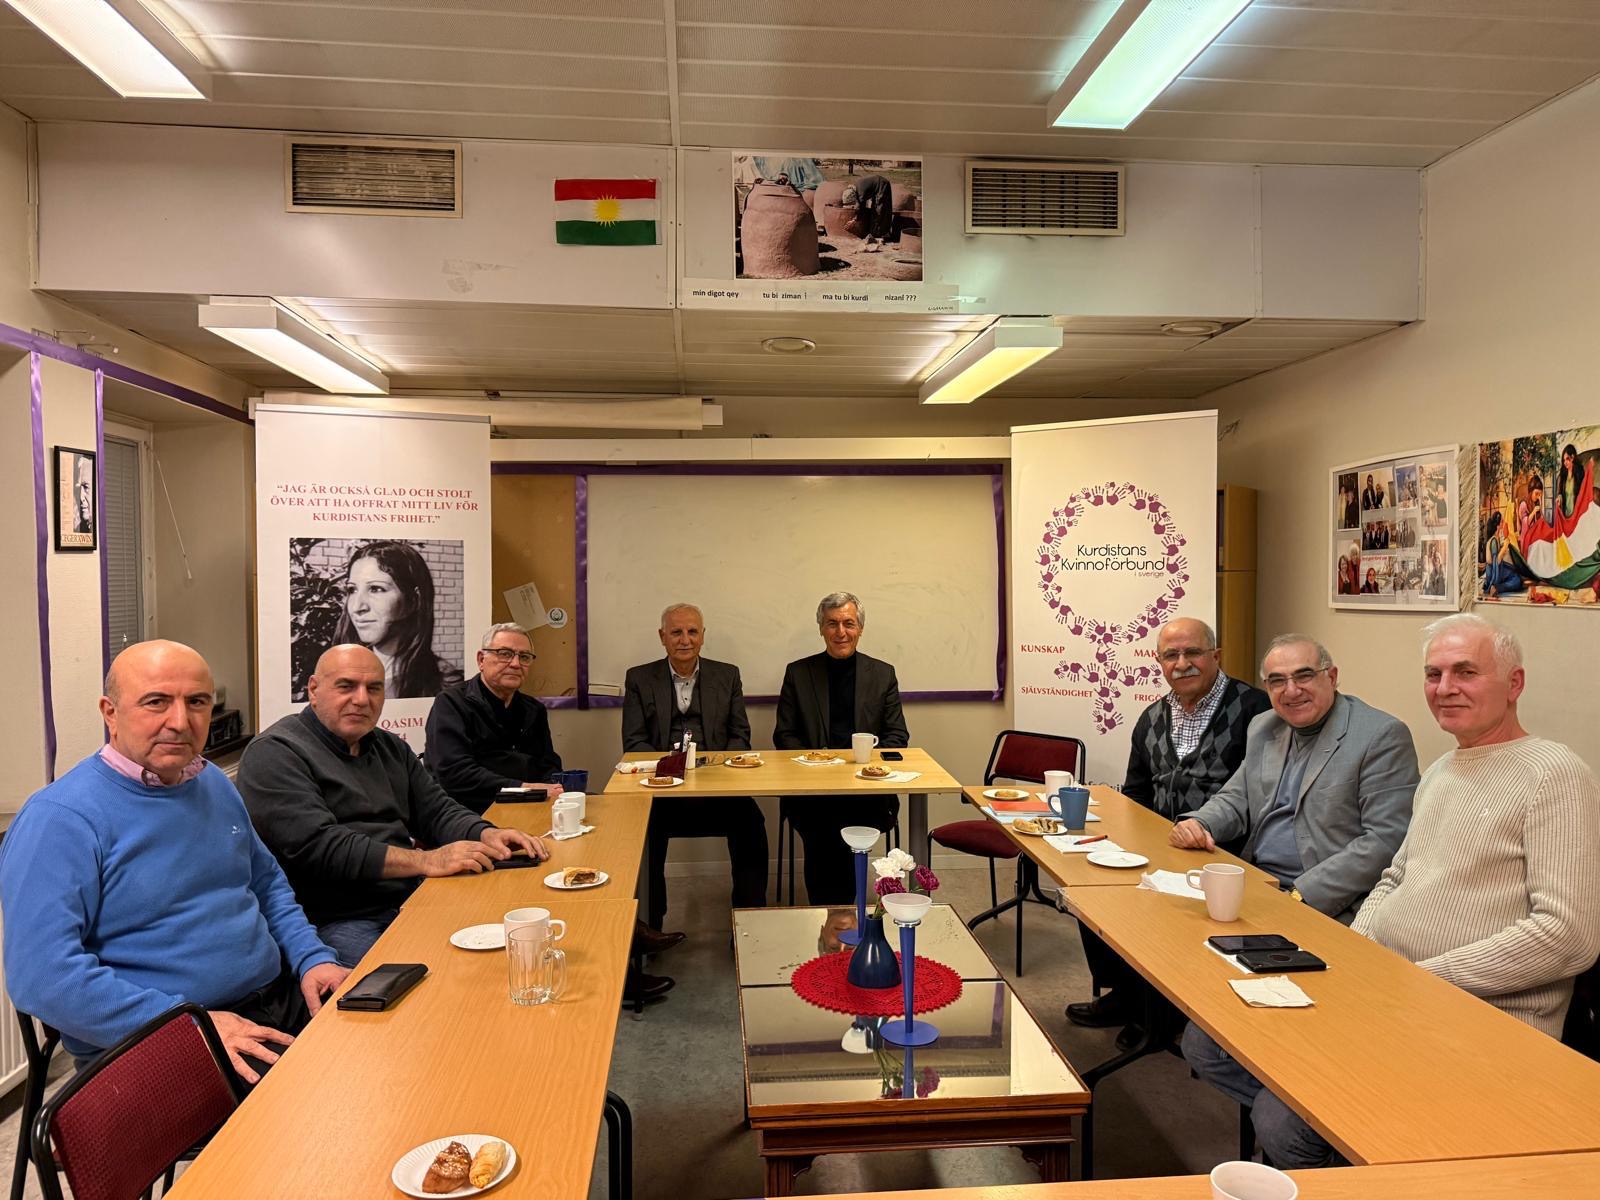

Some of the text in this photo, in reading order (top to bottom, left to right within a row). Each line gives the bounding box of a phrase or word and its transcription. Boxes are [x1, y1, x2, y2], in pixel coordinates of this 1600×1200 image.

[707, 289, 725, 298] digot
[771, 291, 779, 299] bi
[781, 291, 802, 299] ziman
[843, 293, 850, 301] bi
[310, 483, 327, 494] ÄR
[329, 485, 370, 495] OCKSÅ
[373, 487, 406, 496] GLAD
[409, 488, 434, 497] OCH
[437, 489, 472, 498] STOLT
[270, 496, 479, 511] ÖVER ATT HA OFFRAT MITT LIV FÖR
[313, 512, 388, 522] KURDISTANS
[1077, 544, 1147, 556] Kurdistans
[1061, 557, 1165, 571] Kvinnoförbund
[1138, 571, 1164, 579] sverige
[1021, 644, 1158, 658] KUNSKAP MAK
[1021, 686, 1162, 702] SJÄLVSTÄNDIGHET FRIGÖ
[381, 717, 424, 730] QASIM
